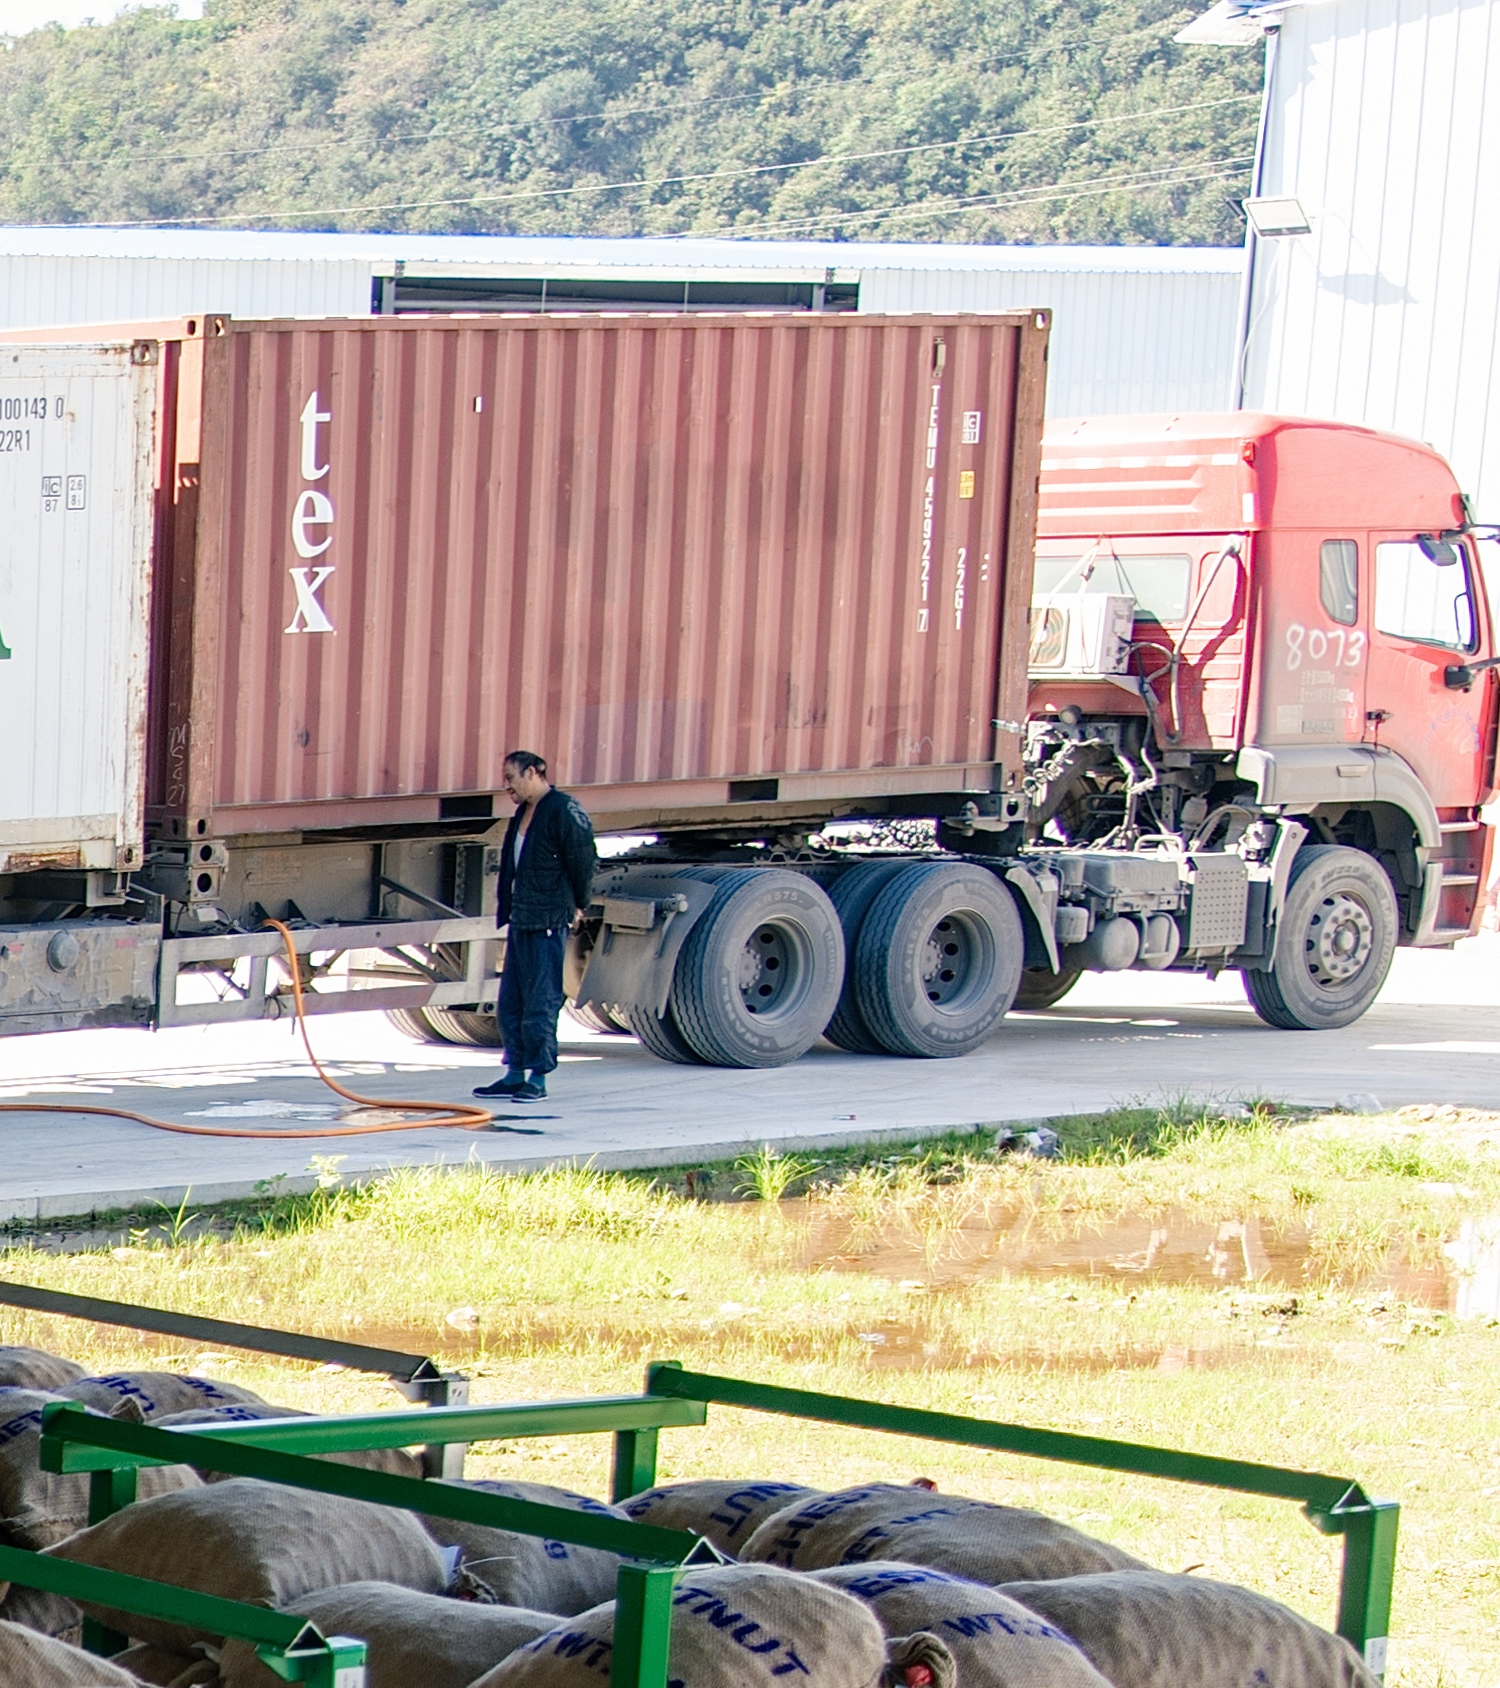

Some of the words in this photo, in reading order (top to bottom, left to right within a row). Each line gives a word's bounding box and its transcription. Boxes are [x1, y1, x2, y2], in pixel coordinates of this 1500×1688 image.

[54, 396, 65, 419] 0
[926, 384, 940, 469] TEMU
[284, 391, 336, 633] tex
[920, 476, 934, 602] 459221
[954, 547, 967, 631] 22G1
[1285, 623, 1365, 670] 8073
[671, 1585, 811, 1679] TNUT
